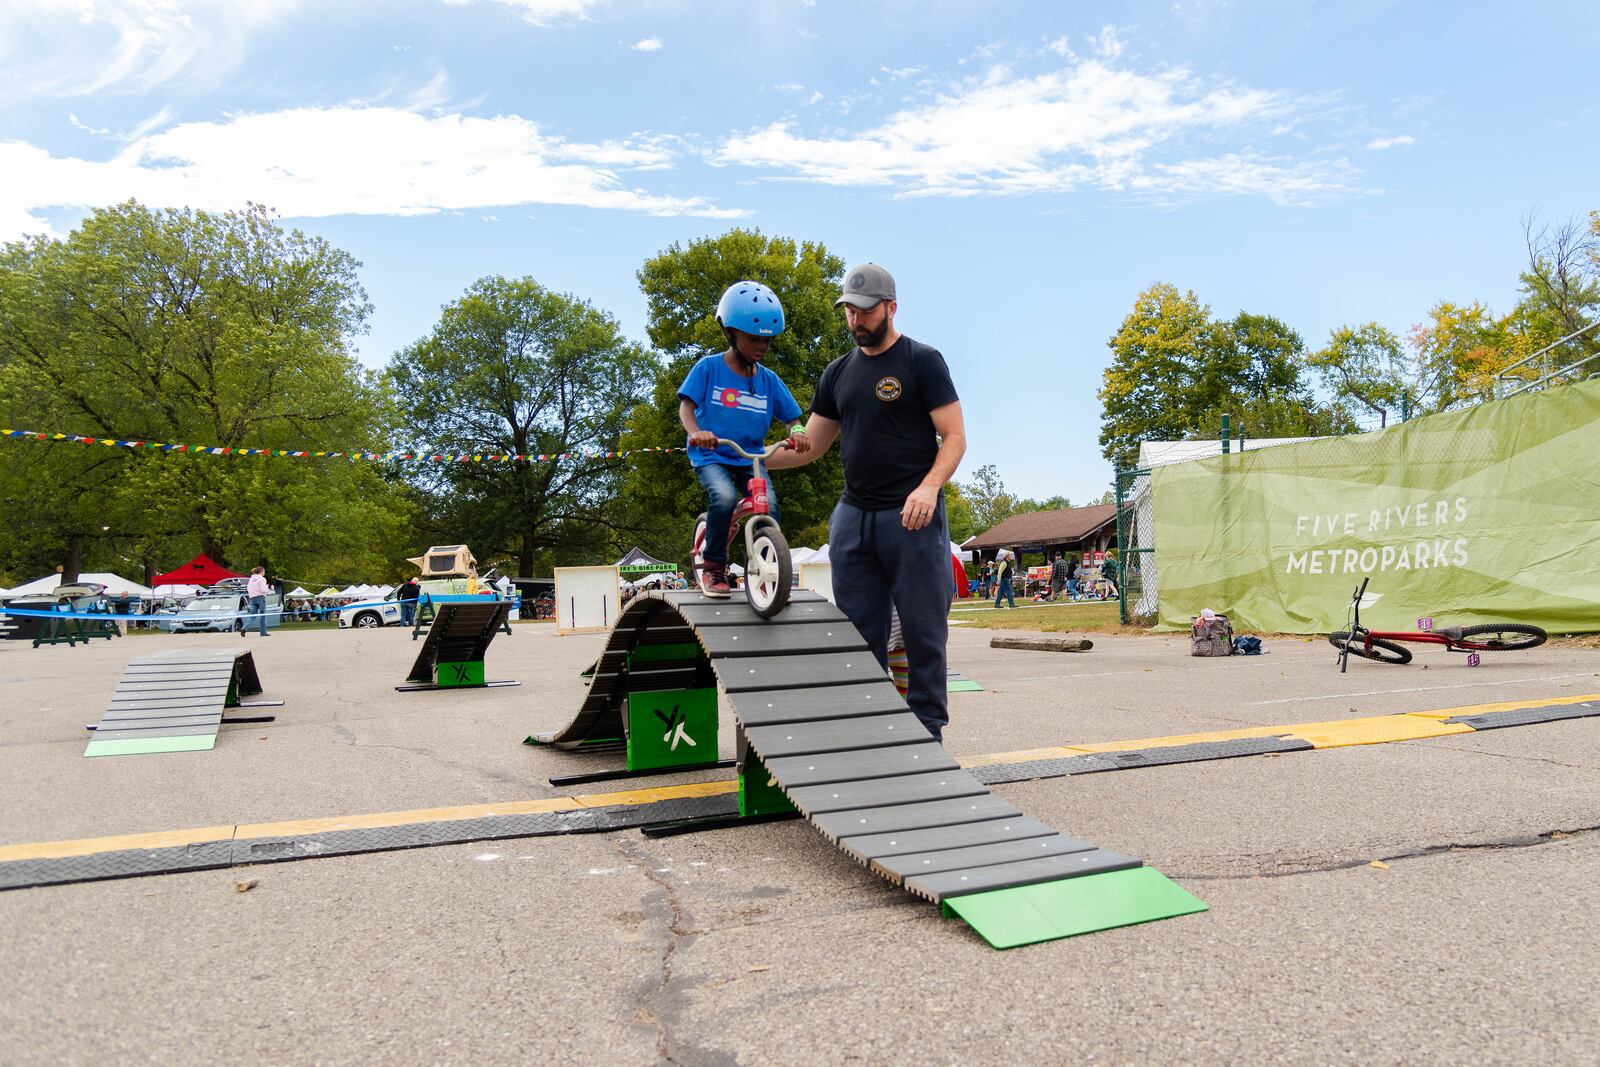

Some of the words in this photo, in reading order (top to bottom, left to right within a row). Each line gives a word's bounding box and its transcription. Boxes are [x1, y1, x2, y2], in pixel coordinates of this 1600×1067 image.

[1296, 512, 1357, 536] FIVE
[1368, 497, 1467, 532] RIVERS
[1286, 538, 1469, 574] METROPARKS
